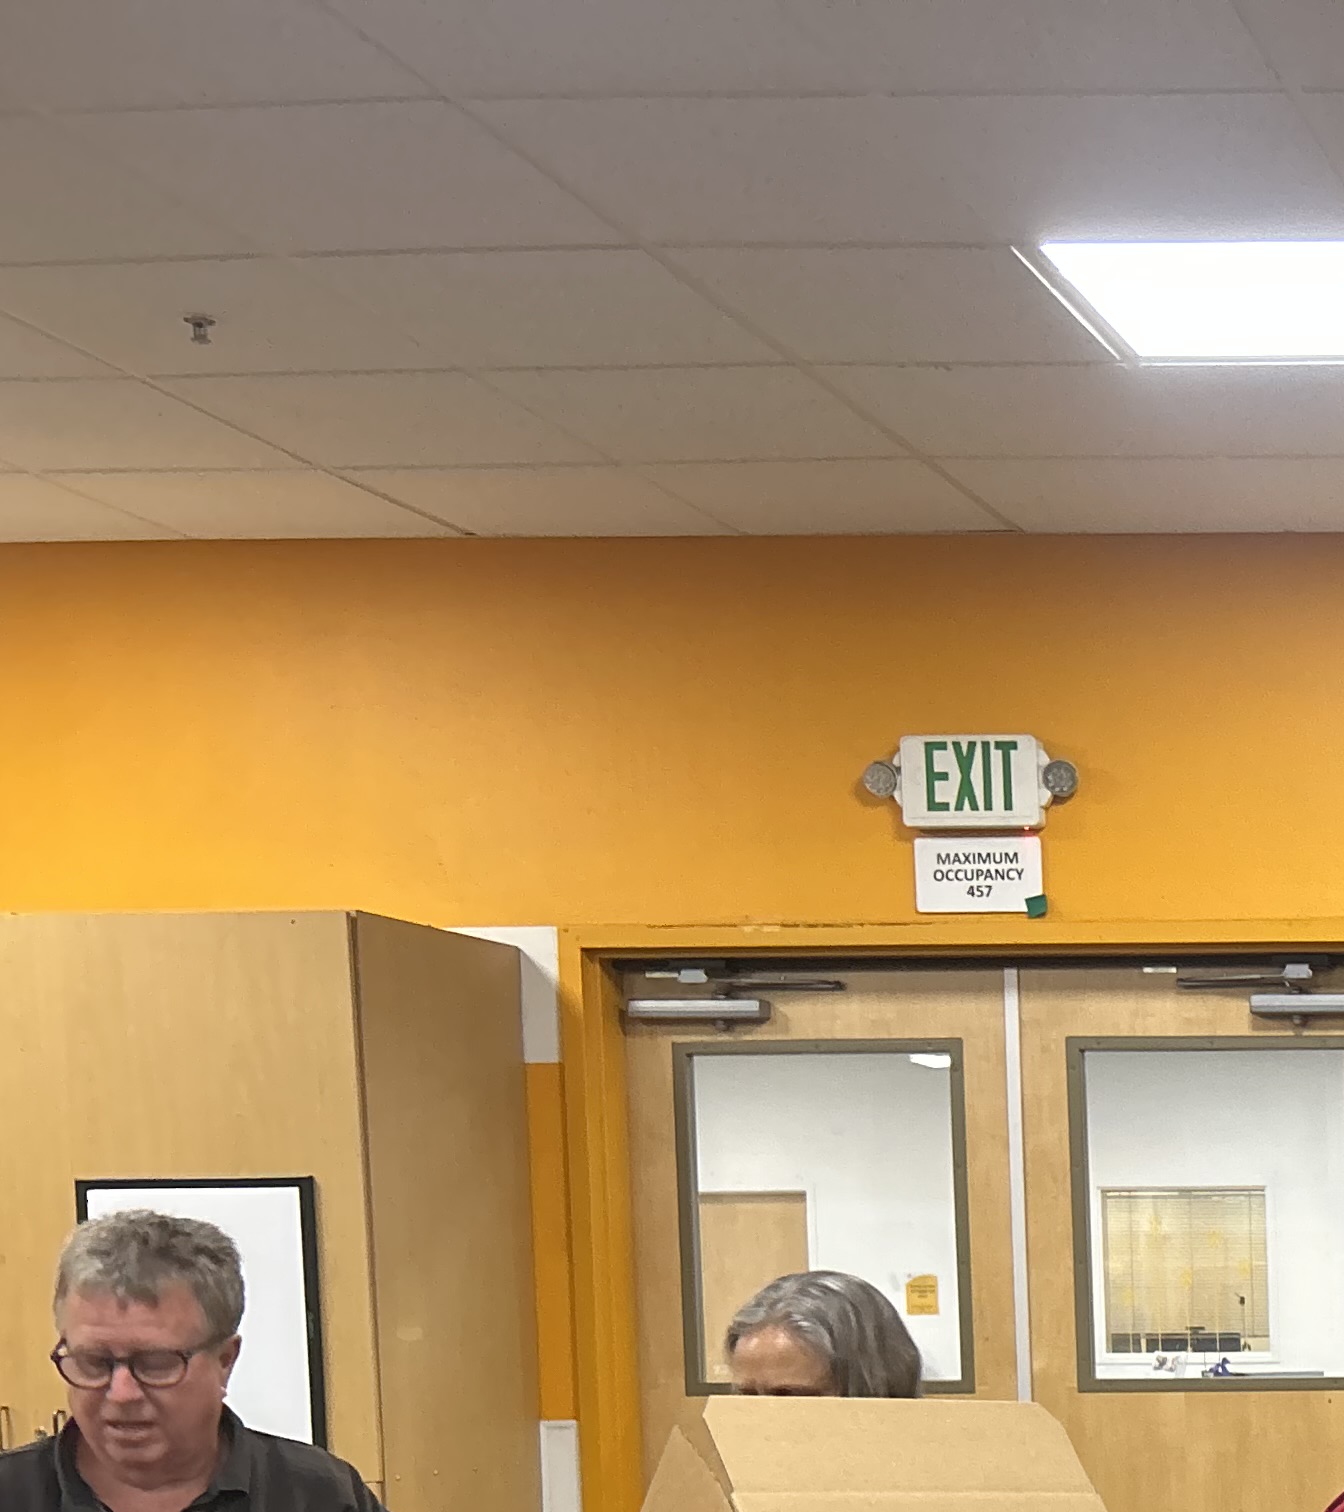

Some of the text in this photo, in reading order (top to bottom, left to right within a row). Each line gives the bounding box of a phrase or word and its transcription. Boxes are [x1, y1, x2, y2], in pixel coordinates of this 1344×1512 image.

[924, 741, 1018, 812] EXIT
[936, 852, 1019, 865] MAXIMUM
[933, 868, 1024, 882] OCCUPANCY
[966, 885, 992, 898] 457
